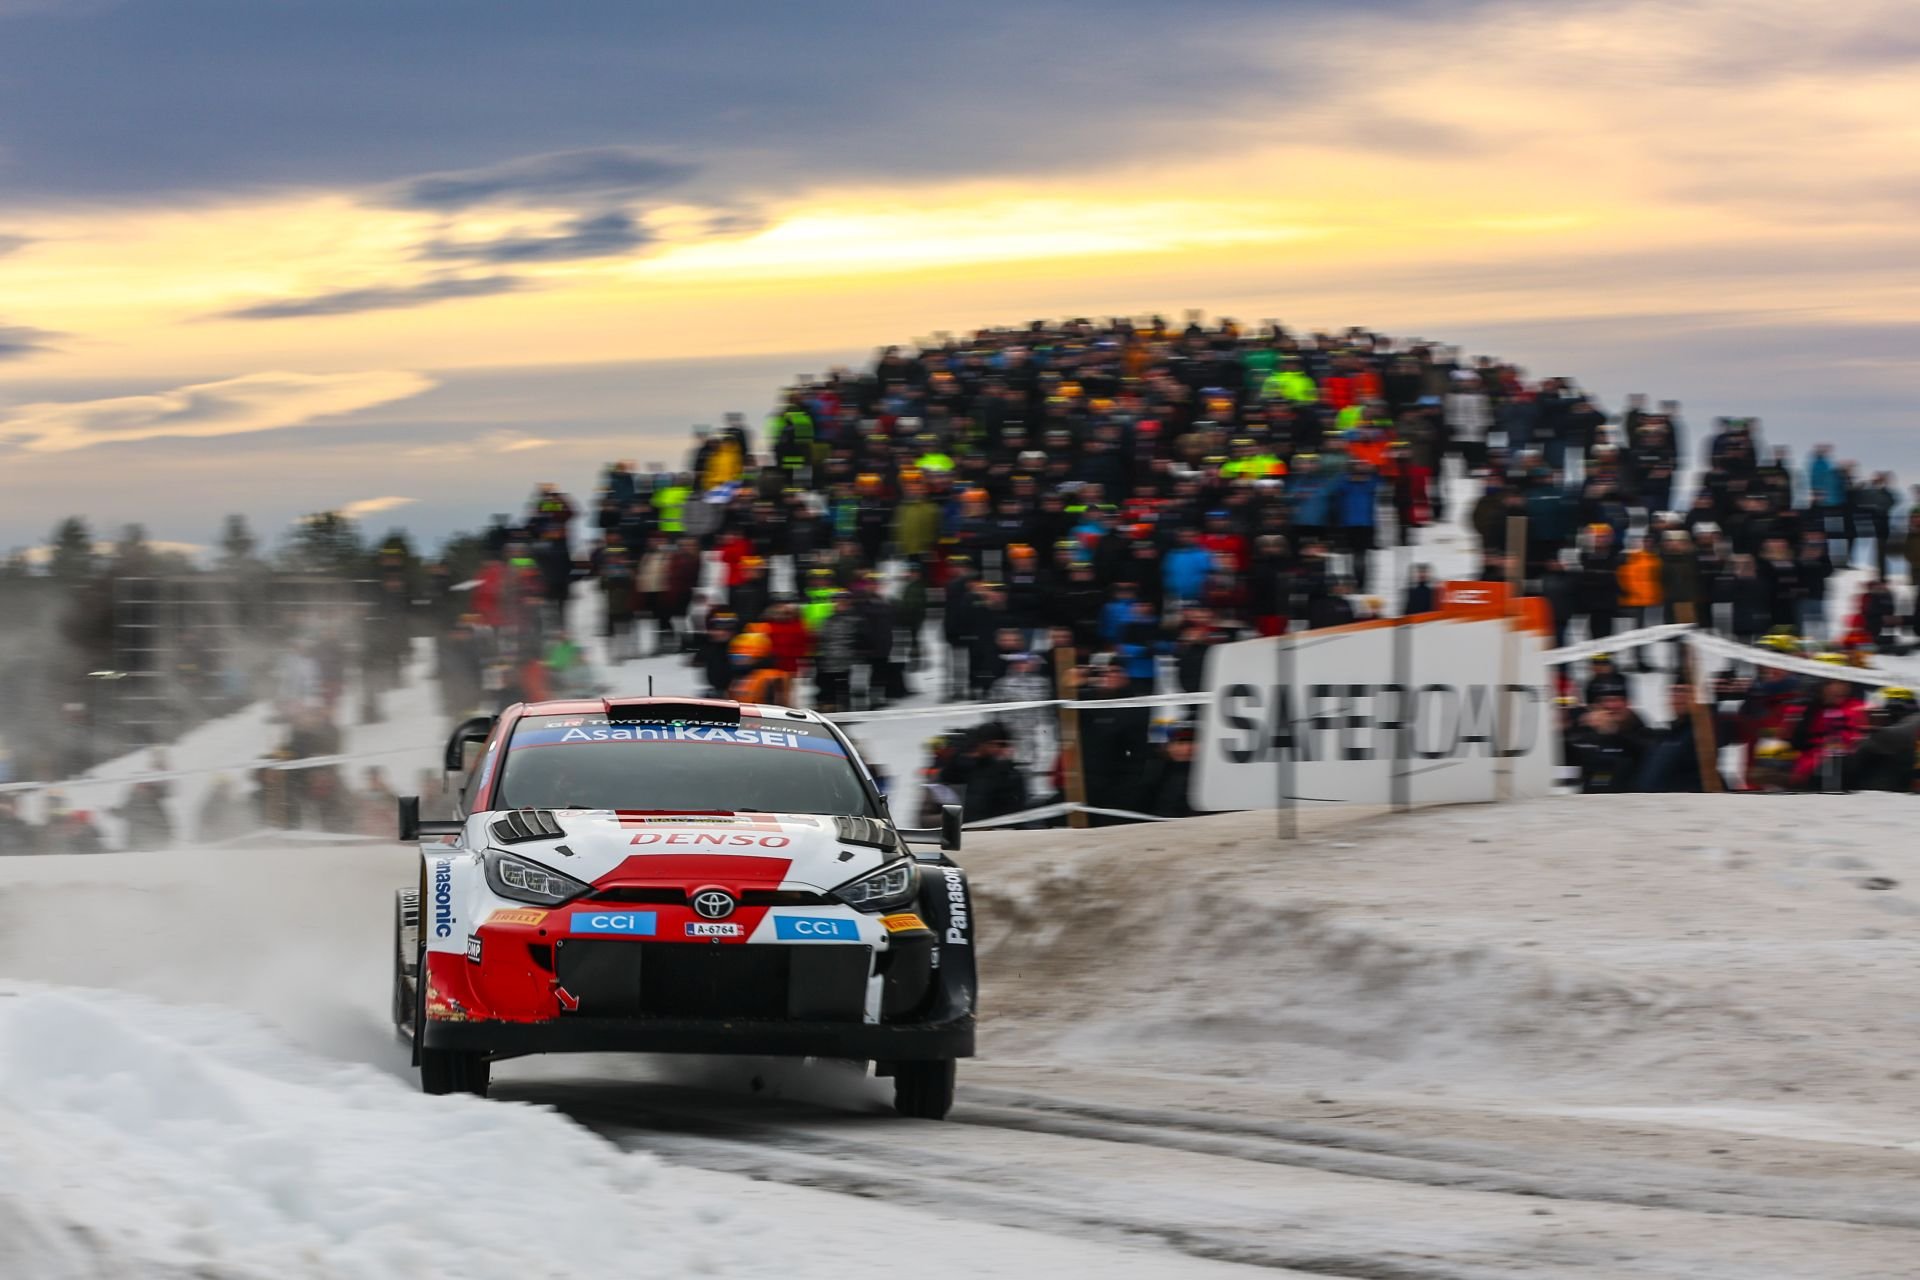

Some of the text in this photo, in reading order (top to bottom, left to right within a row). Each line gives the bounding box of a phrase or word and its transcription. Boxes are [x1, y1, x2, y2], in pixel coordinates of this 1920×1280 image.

[588, 719, 666, 727] TOYOTA
[1218, 683, 1541, 763] SAFEROAD
[629, 833, 790, 848] DENSO
[697, 925, 734, 934] A-6764
